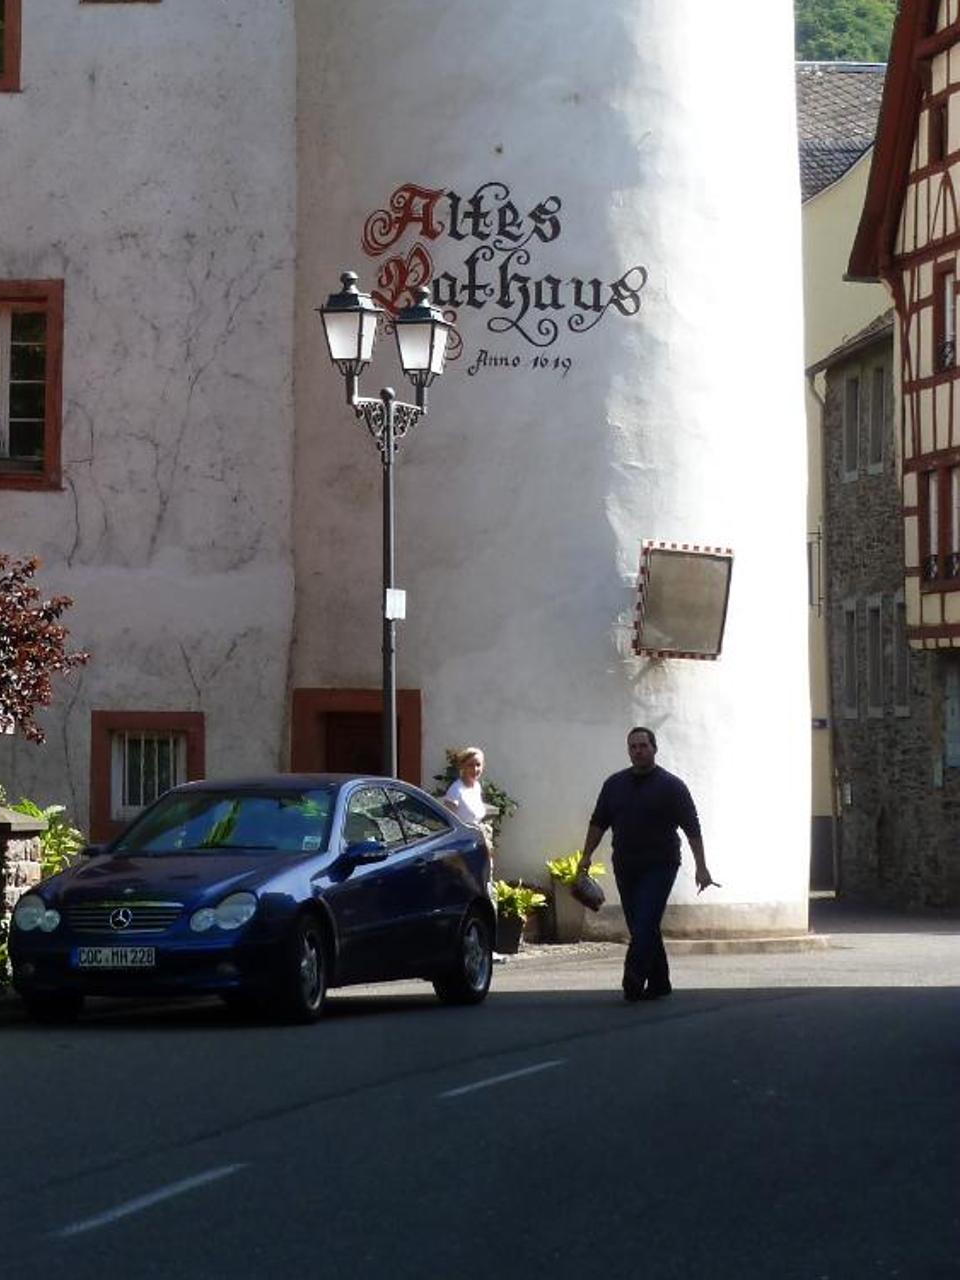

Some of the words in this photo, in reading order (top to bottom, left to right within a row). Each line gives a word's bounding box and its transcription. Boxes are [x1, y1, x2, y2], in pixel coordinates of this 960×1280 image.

[361, 181, 562, 257] Altes
[372, 243, 648, 356] Rathaus
[467, 348, 521, 377] Anno
[532, 352, 573, 379] 1619
